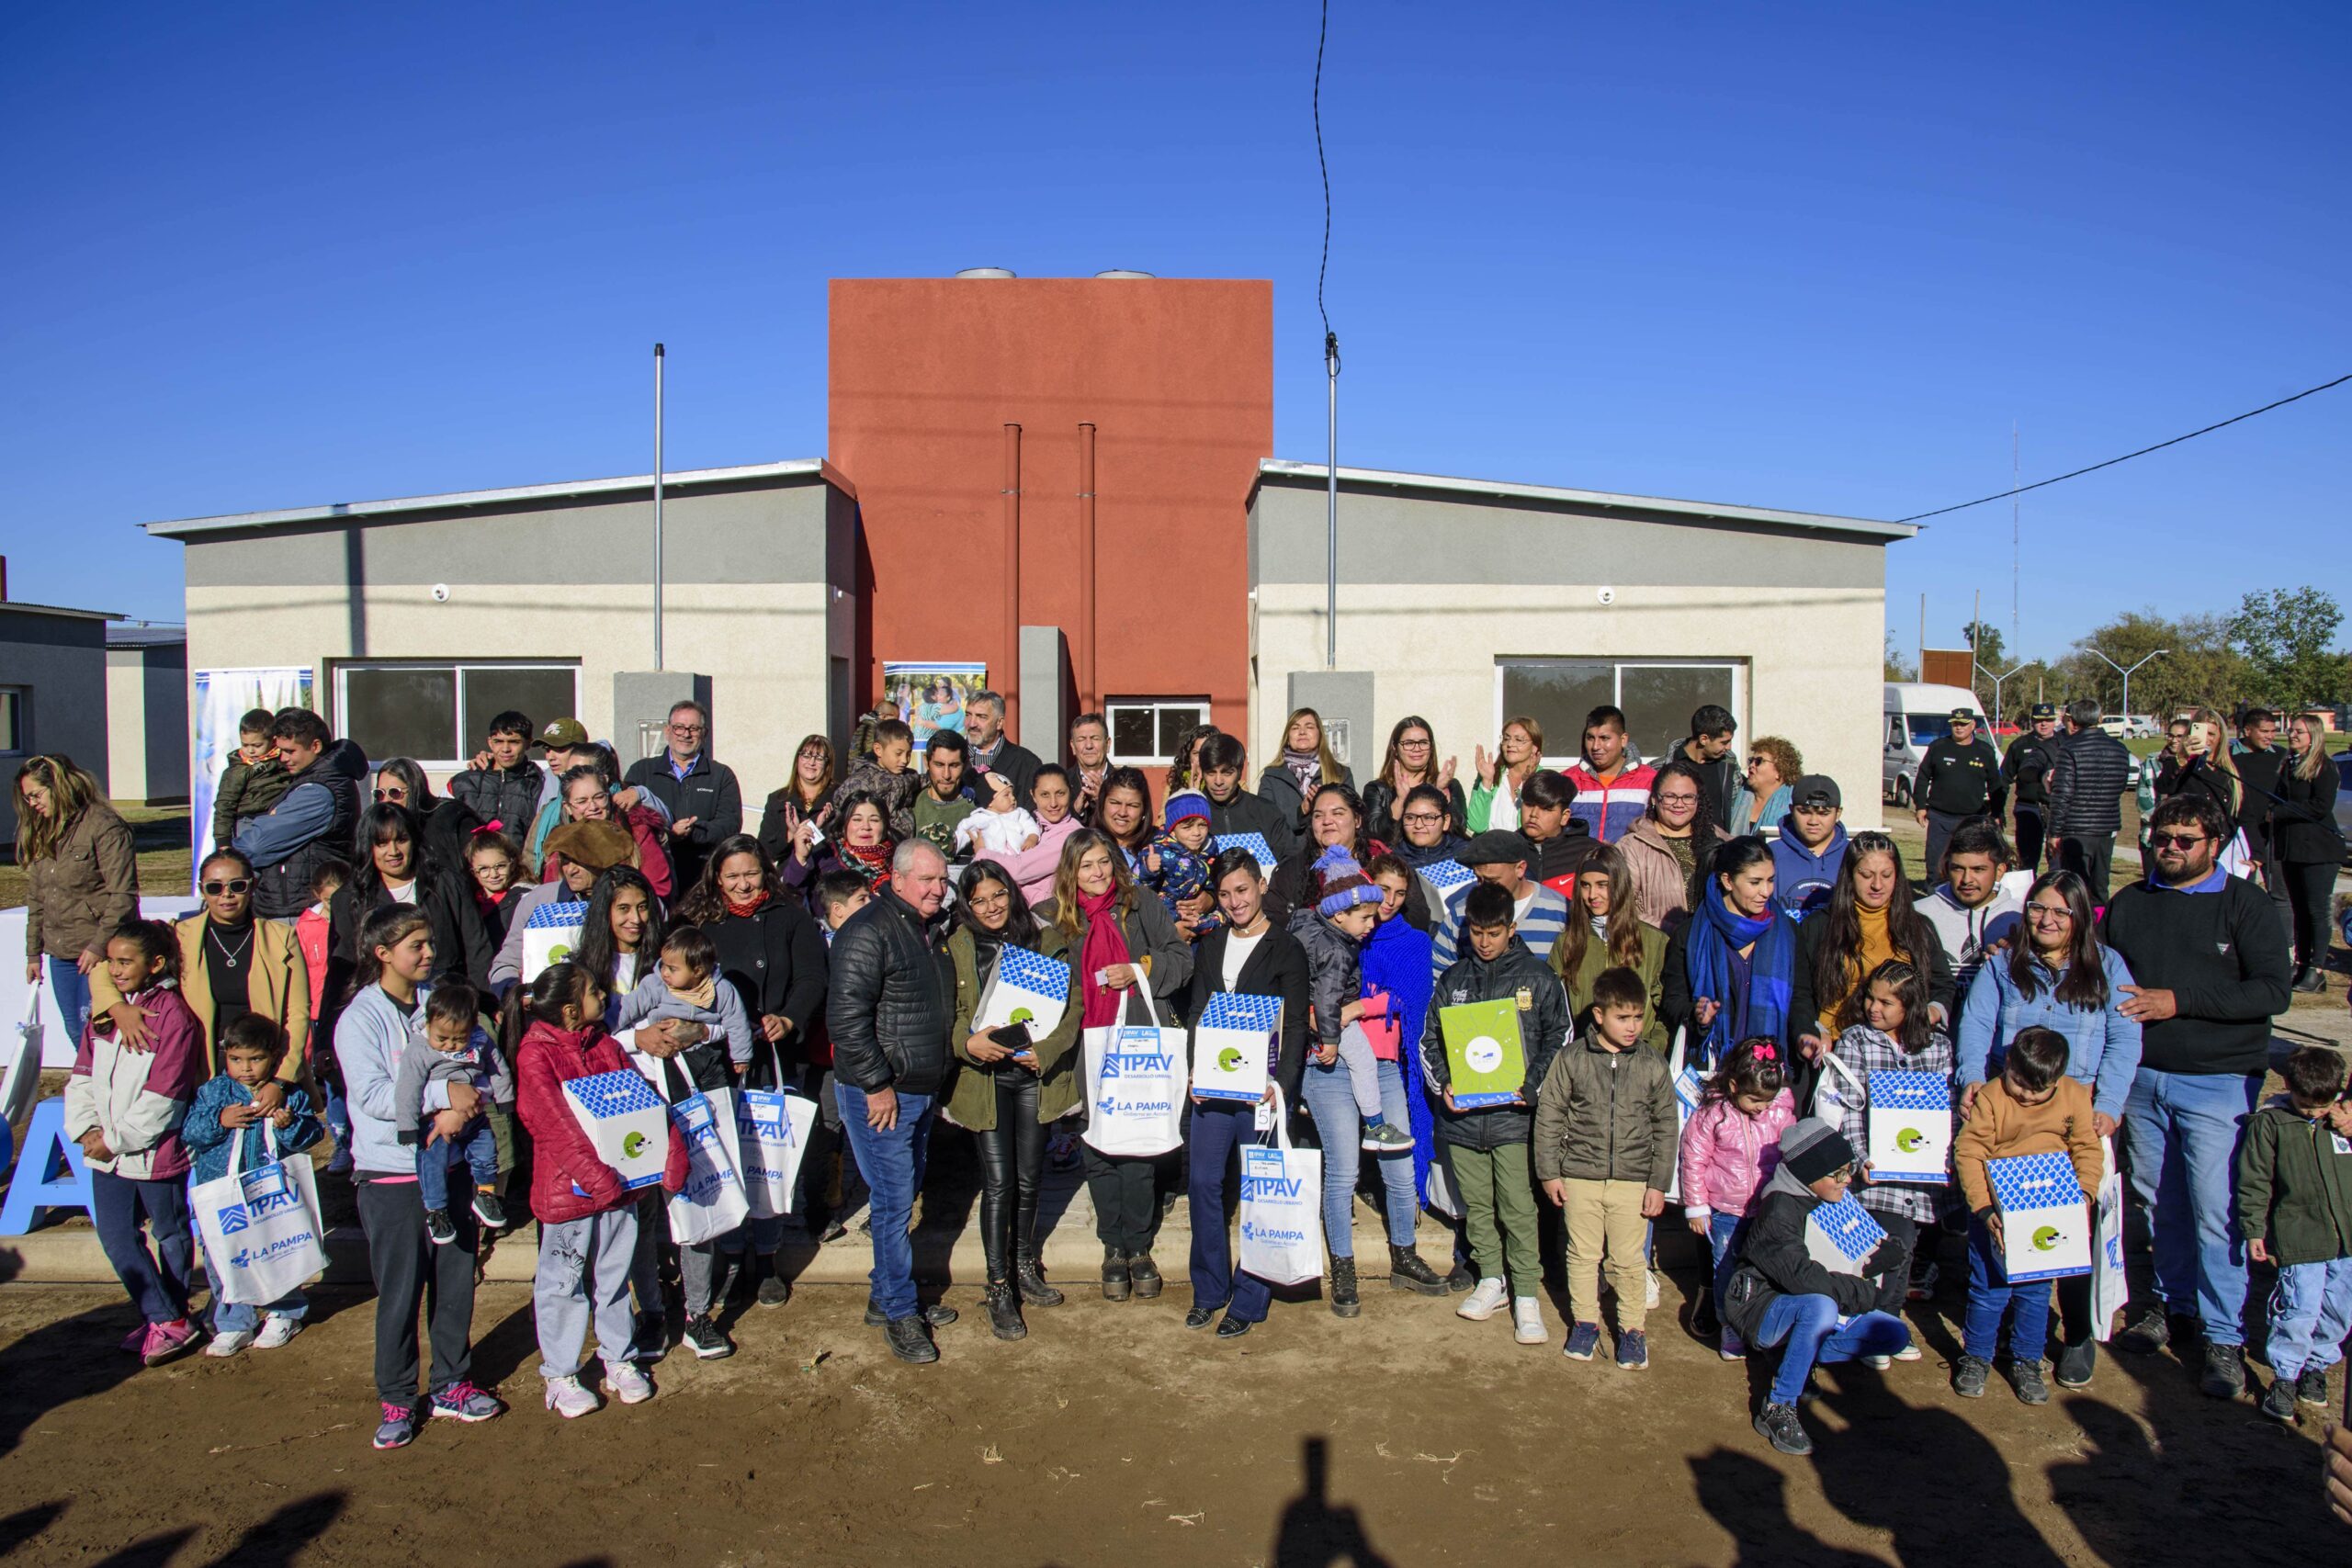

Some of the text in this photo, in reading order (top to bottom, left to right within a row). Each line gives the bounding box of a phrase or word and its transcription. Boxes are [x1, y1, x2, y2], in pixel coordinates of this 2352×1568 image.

[1125, 1055, 1173, 1071] IPAV
[1117, 1101, 1132, 1111] LA
[1259, 1109, 1269, 1125] 5
[692, 1180, 705, 1194] LA
[705, 1168, 735, 1184] PAMP
[1256, 1178, 1303, 1198] IPAV
[250, 1182, 300, 1218] IPAV
[1255, 1227, 1305, 1241] LA PAMPA
[253, 1232, 313, 1260] LA PAMPA
